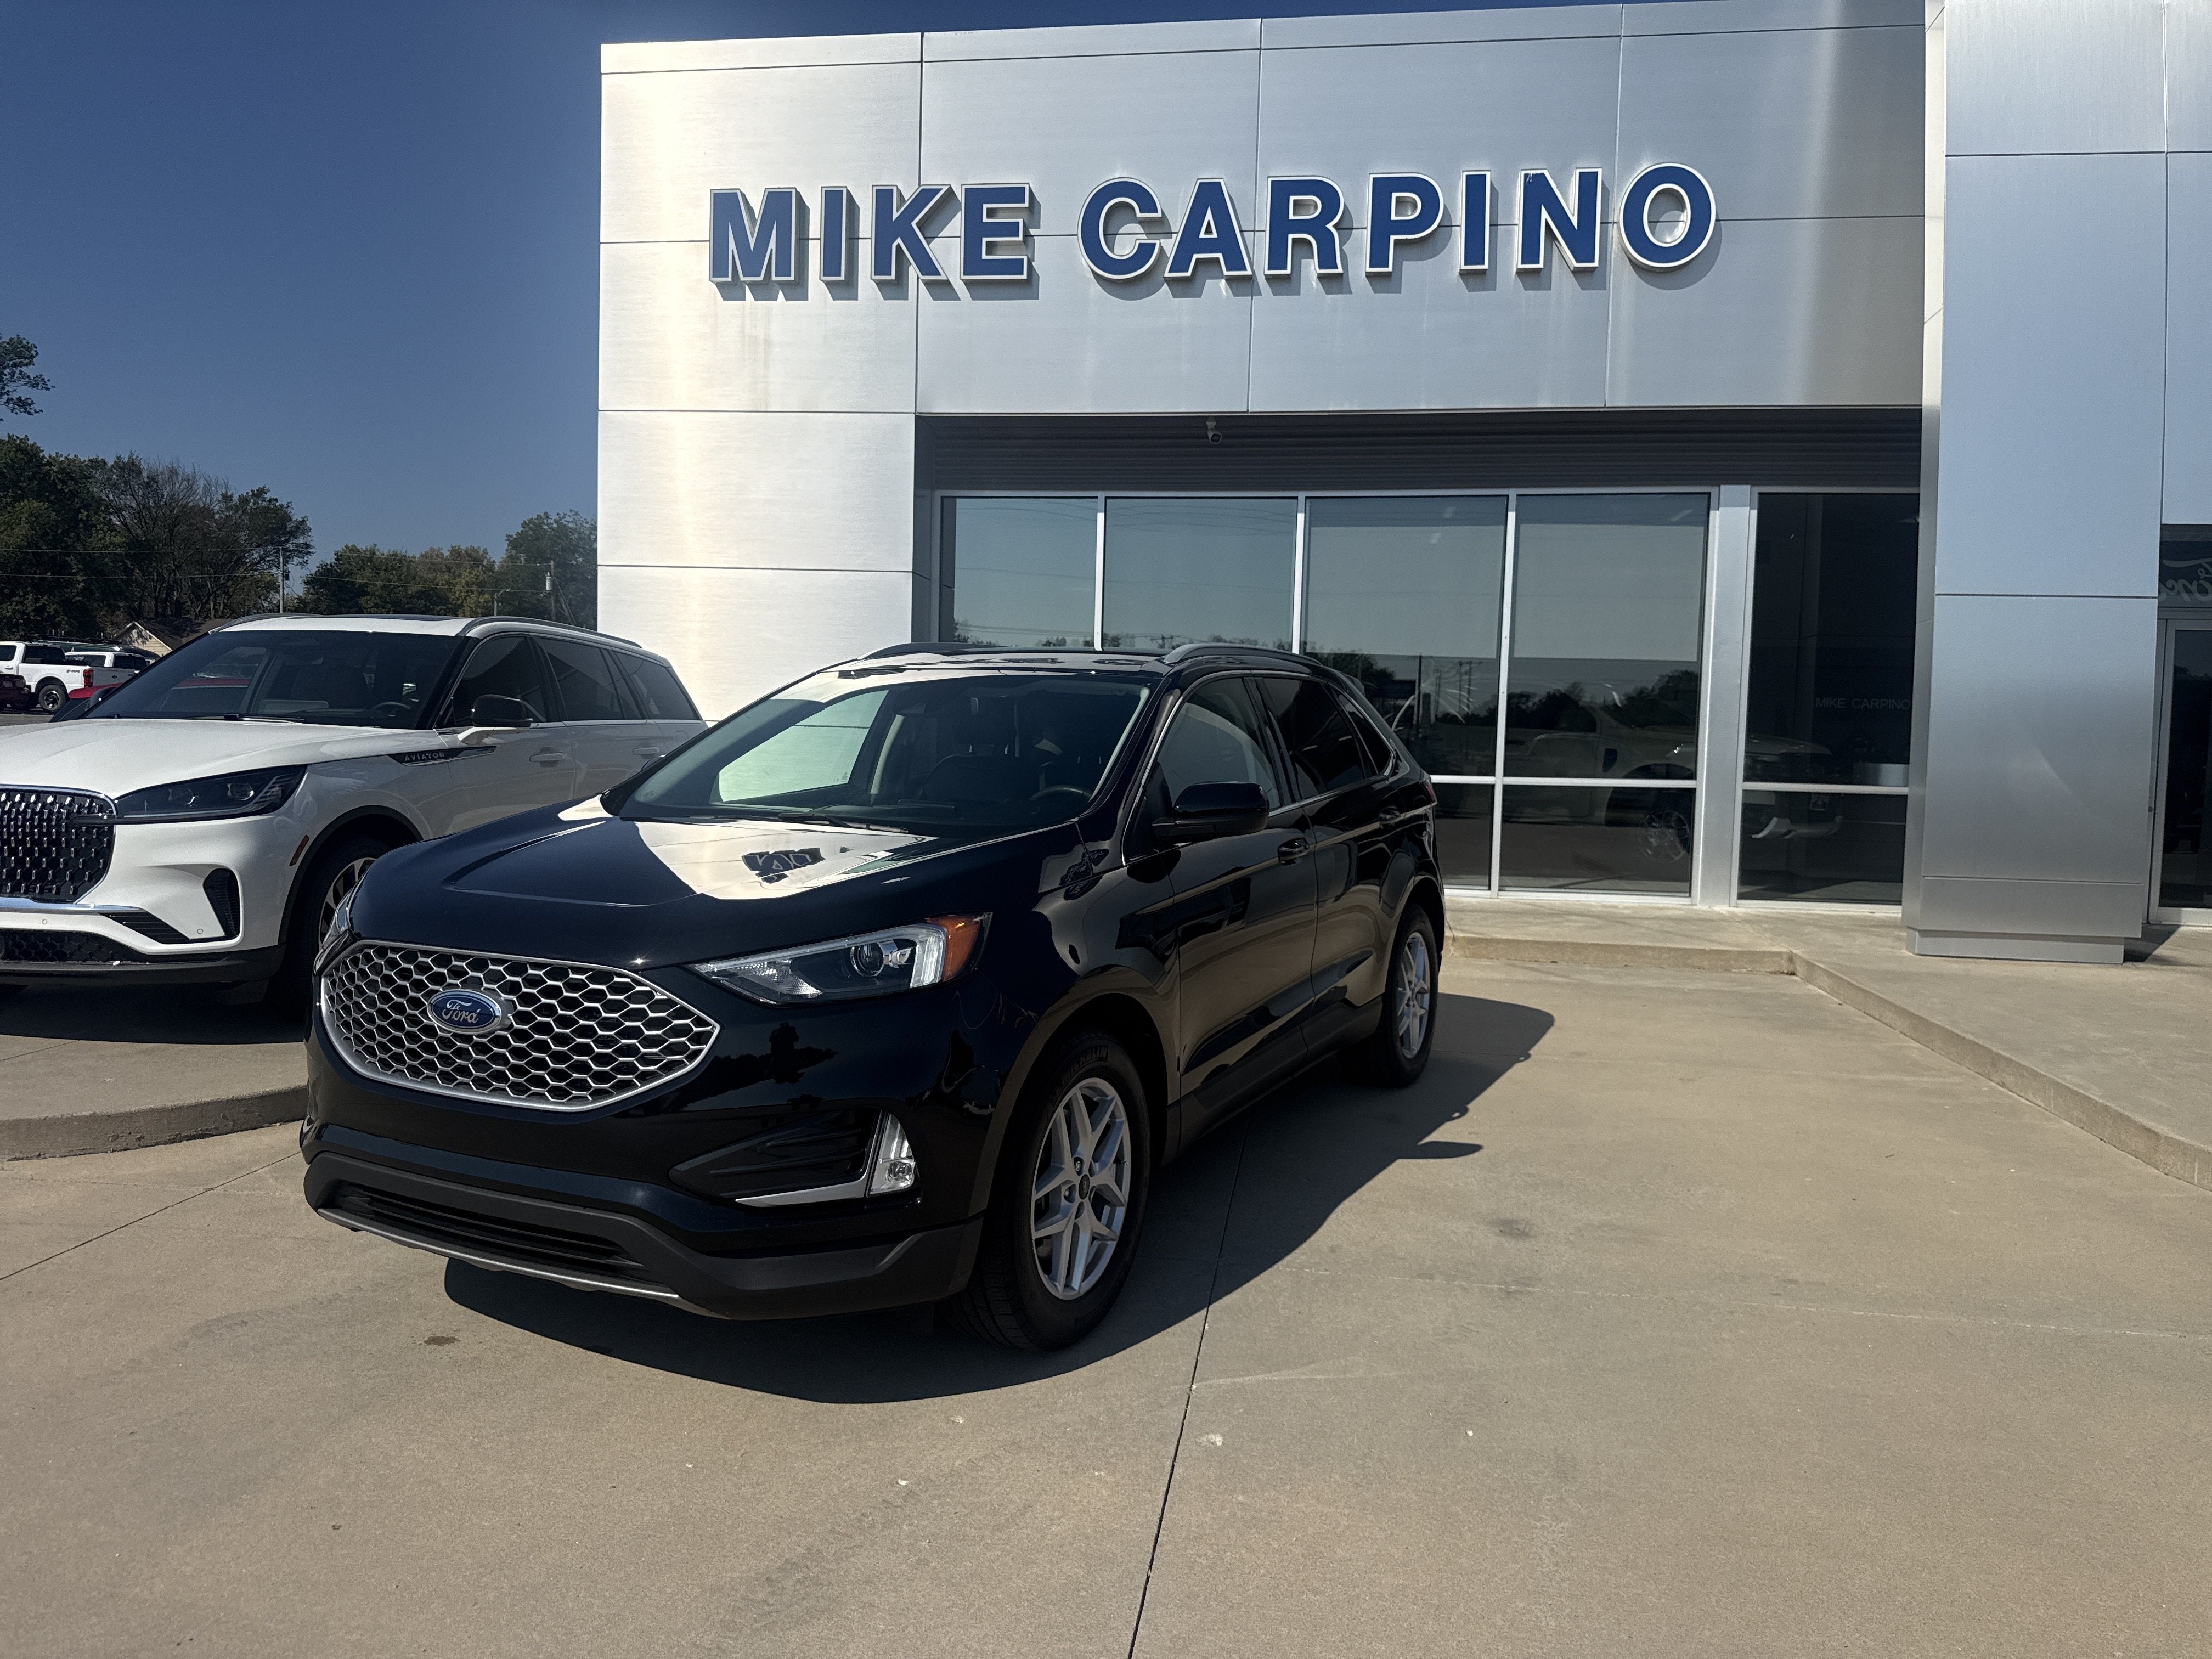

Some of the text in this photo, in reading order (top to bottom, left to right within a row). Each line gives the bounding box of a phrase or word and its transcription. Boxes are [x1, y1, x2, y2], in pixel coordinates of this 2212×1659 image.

[709, 163, 1717, 283] MIKE CARPINO
[1815, 697, 1911, 710] MIKE CARPINO
[404, 752, 445, 761] AVIATOR
[442, 999, 481, 1024] Ford
[1063, 1046, 1108, 1086] MICHELIN
